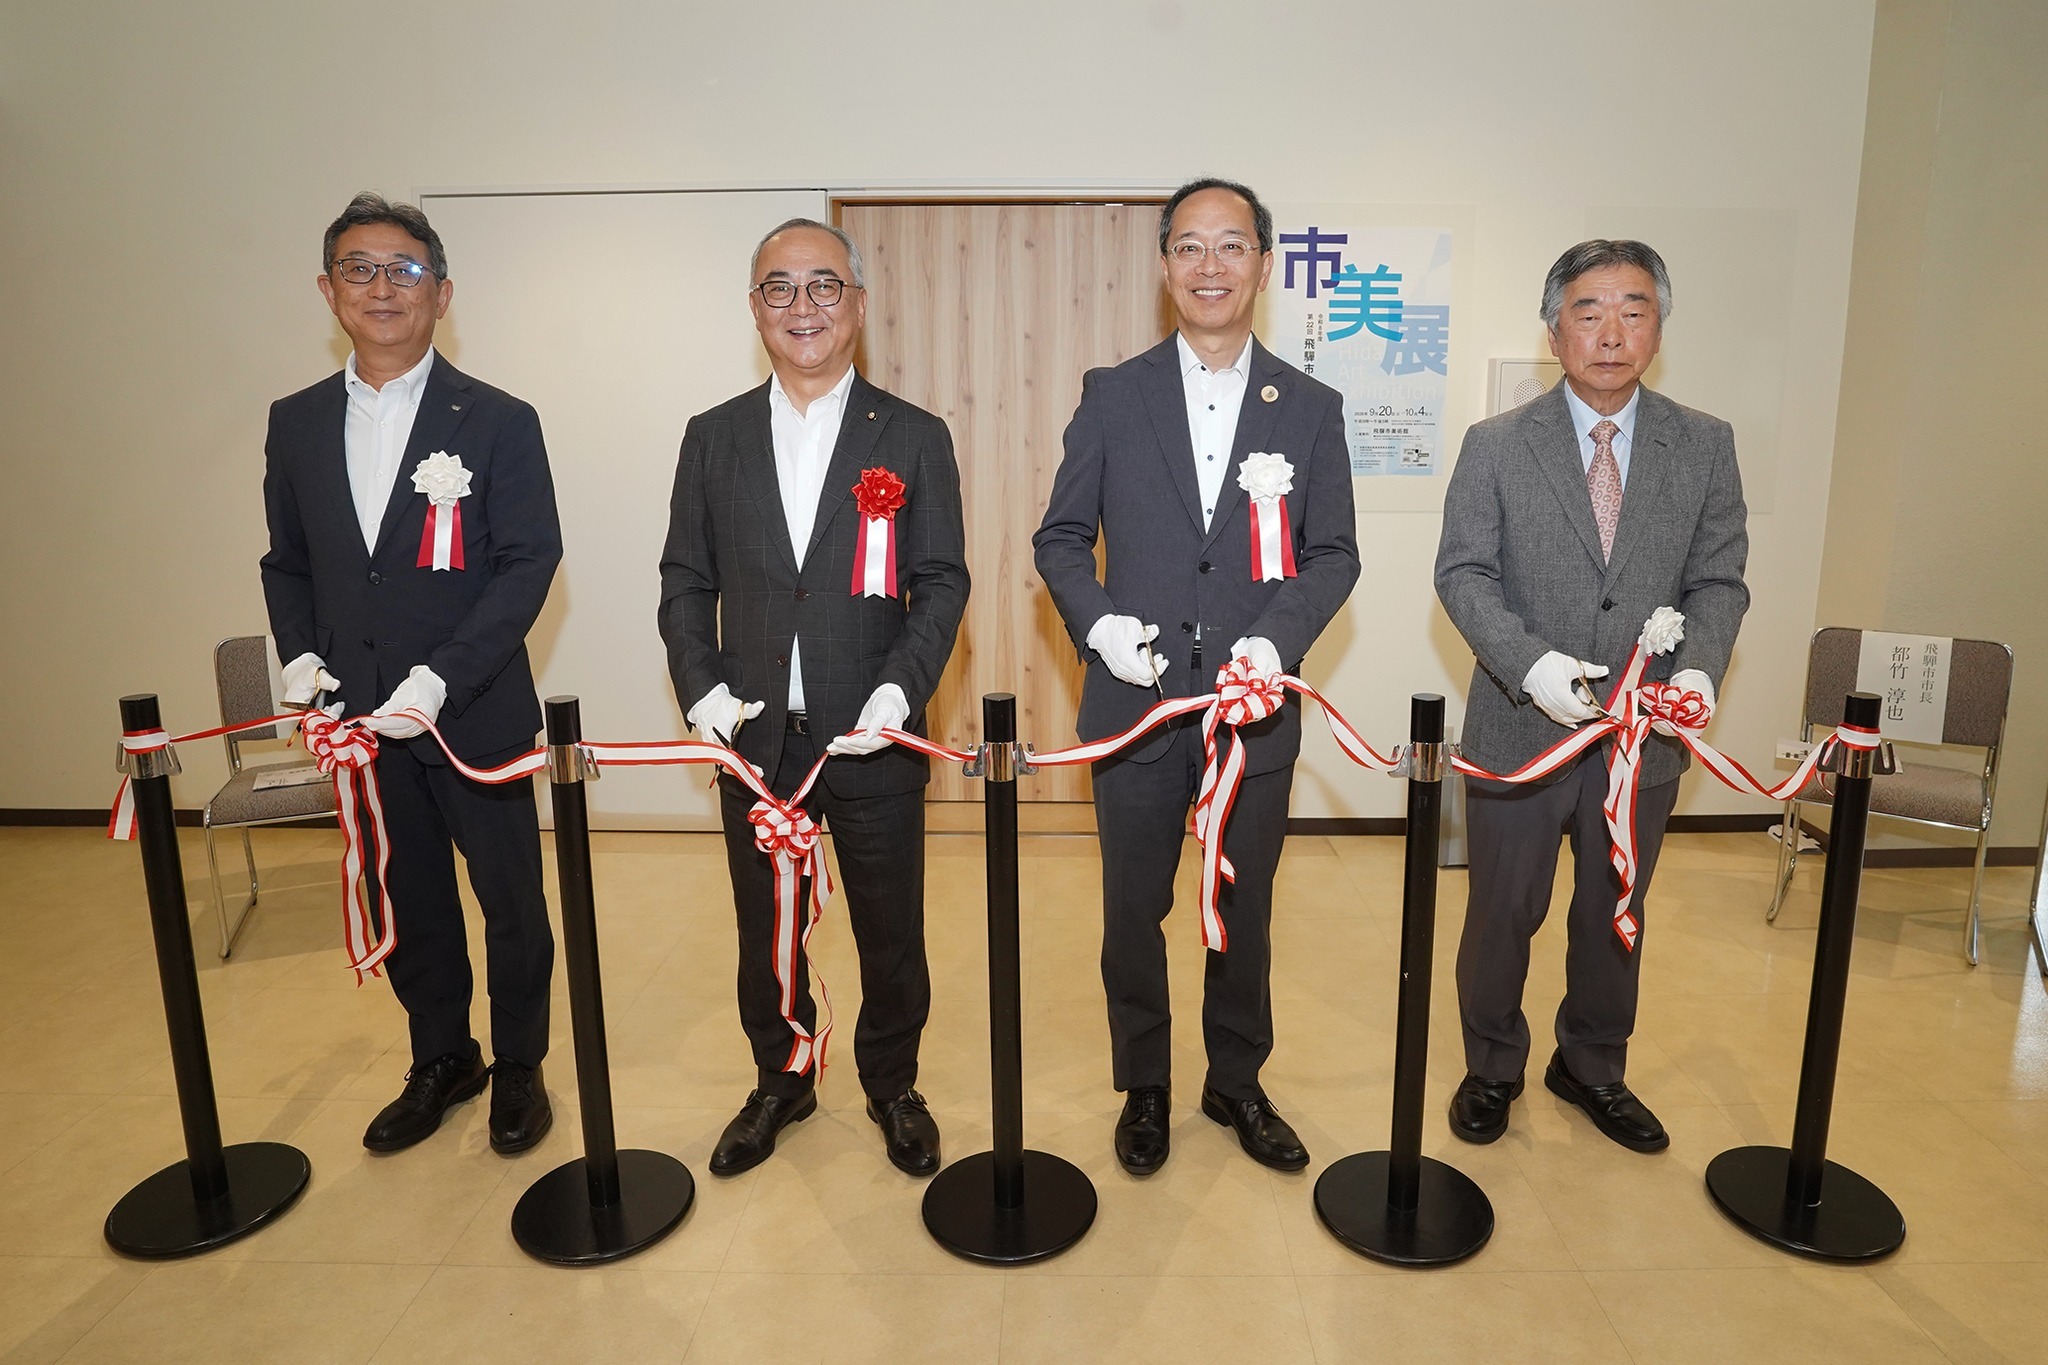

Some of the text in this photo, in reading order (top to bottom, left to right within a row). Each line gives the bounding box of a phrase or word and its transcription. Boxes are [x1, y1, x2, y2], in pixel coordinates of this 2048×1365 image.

[1279, 227, 1449, 376] 市美展
[1339, 344, 1381, 361] Hida
[1337, 363, 1366, 380] Art
